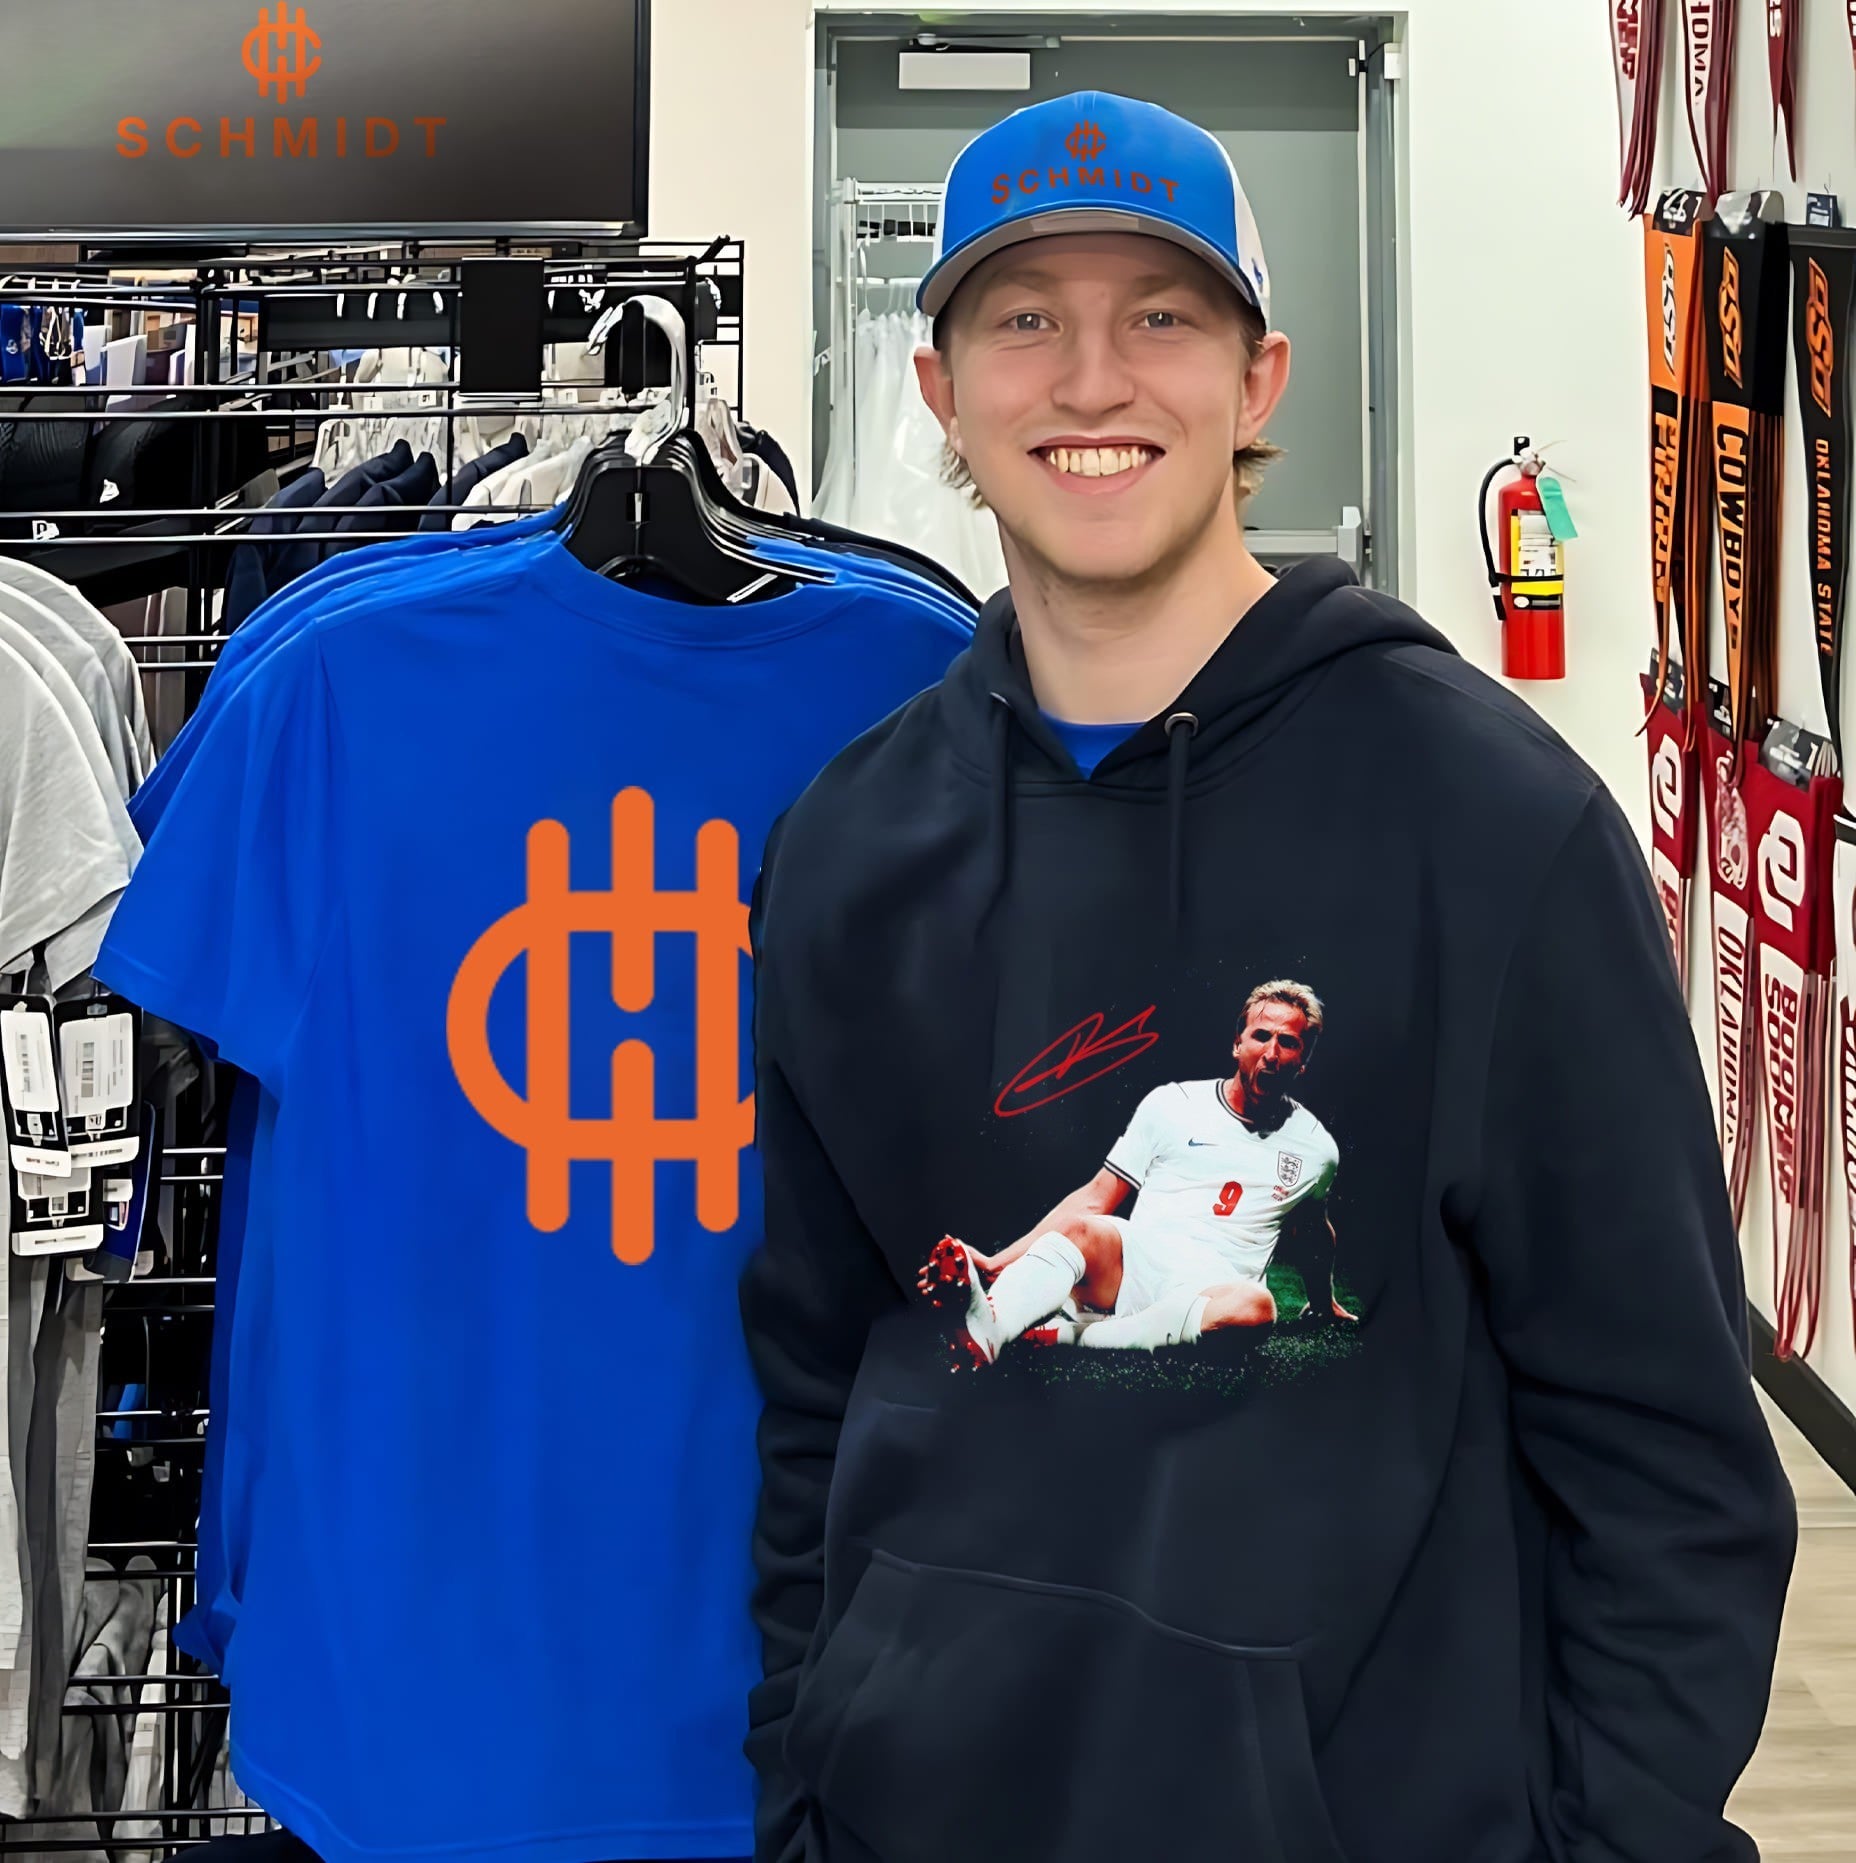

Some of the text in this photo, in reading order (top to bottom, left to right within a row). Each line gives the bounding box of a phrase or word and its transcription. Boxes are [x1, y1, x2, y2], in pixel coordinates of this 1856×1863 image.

[116, 117, 447, 158] SCHMIDT
[991, 166, 1180, 205] SCHMIDT
[1815, 438, 1833, 570] OKLAHOMA
[1212, 1180, 1244, 1217] 9
